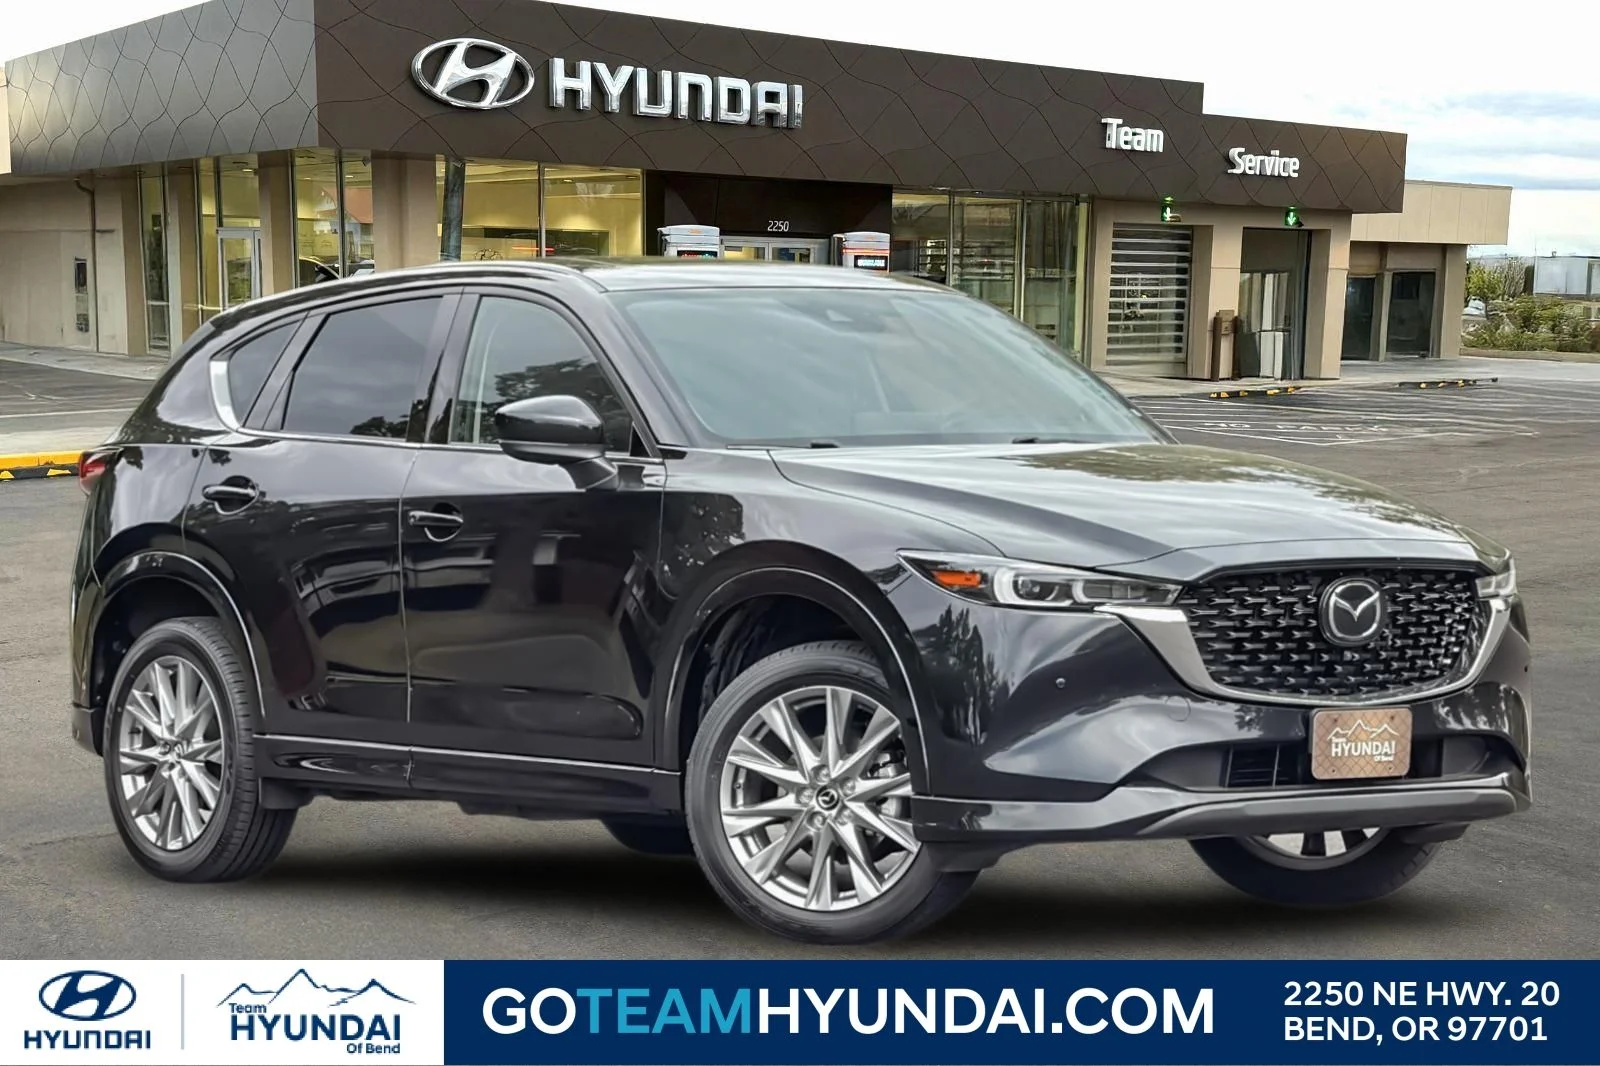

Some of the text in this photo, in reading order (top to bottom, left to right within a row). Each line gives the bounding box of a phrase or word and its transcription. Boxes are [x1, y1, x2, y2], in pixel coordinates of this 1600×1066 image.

[548, 57, 803, 129] HYUNDAI
[1101, 117, 1164, 153] Team
[1227, 147, 1300, 178] Service
[767, 220, 790, 232] 2250
[1331, 741, 1396, 757] HYUNDAI
